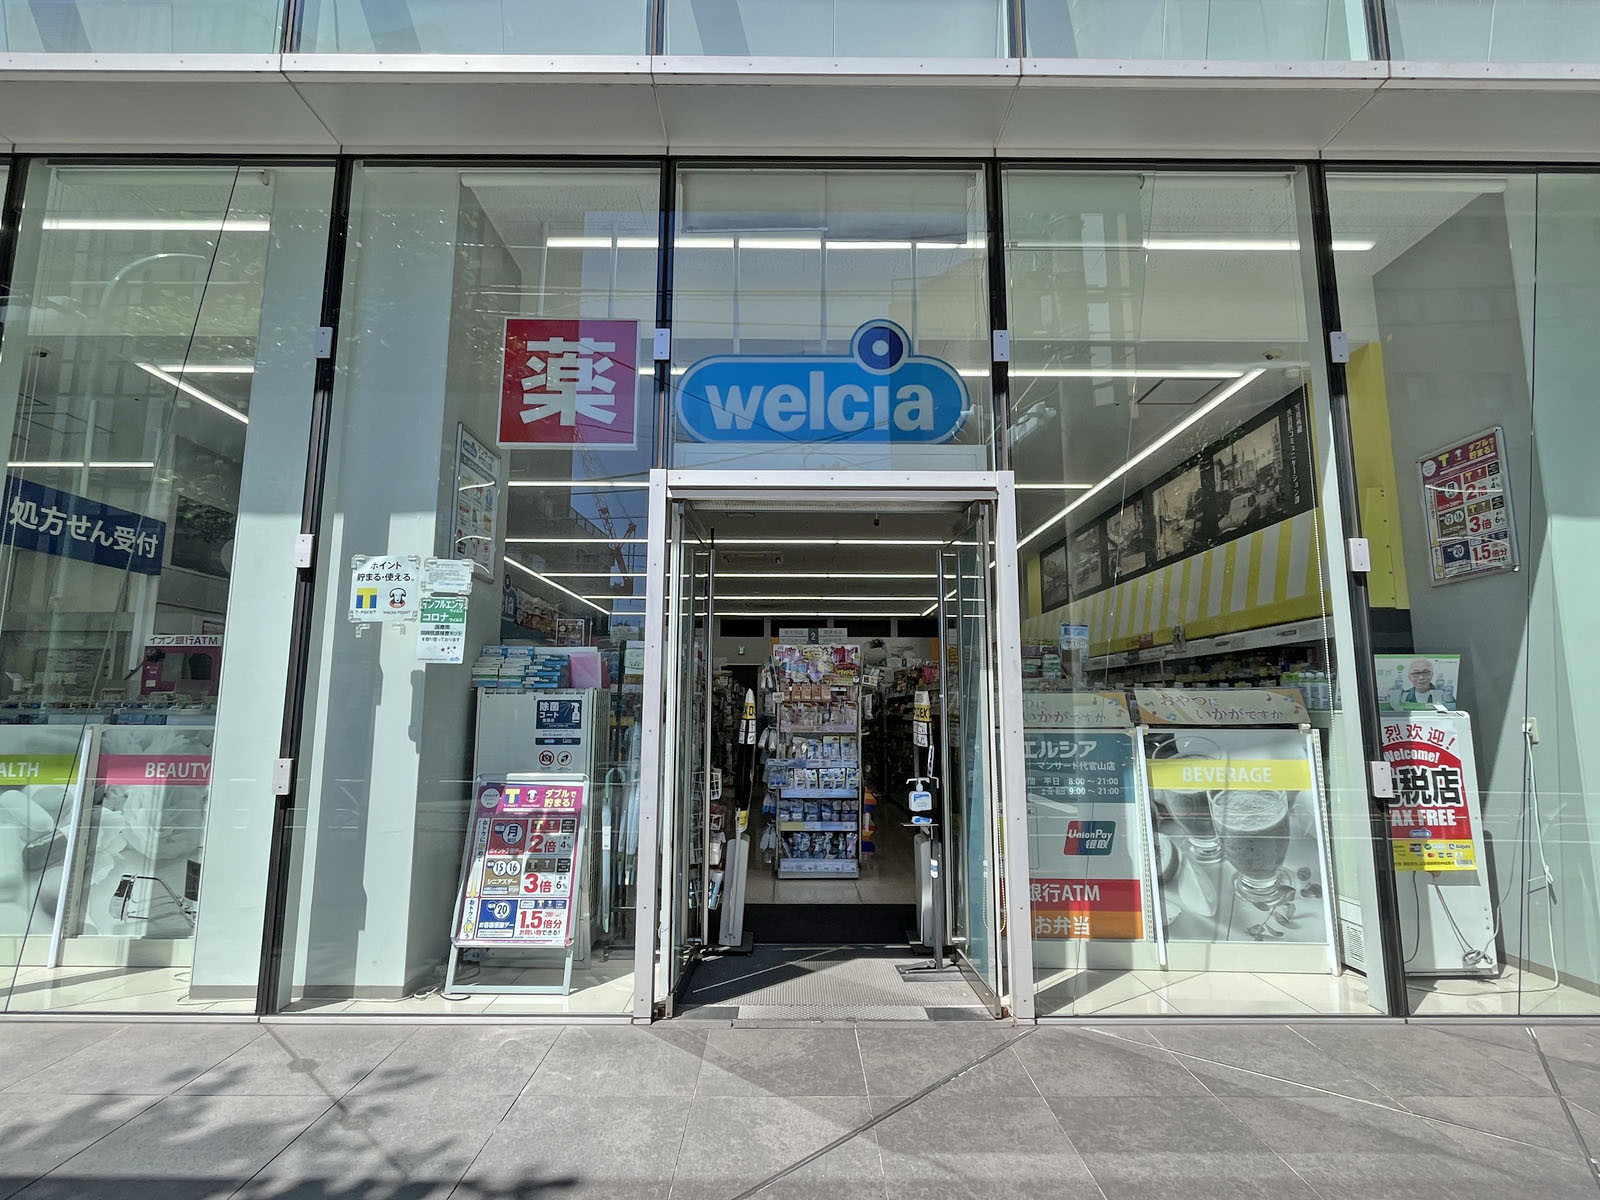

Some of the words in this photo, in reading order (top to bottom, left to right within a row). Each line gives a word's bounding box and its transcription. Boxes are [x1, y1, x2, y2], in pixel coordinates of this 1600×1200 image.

[519, 337, 617, 427] 薬
[704, 370, 936, 431] welcia
[9, 496, 159, 558] 処方せん受付
[370, 561, 402, 570] ポイント
[422, 613, 449, 622] コロナ
[150, 636, 218, 645] イオン銀行ATM
[810, 632, 816, 641] 2
[1160, 694, 1219, 708] おやつに
[1195, 708, 1284, 721] いかがですか
[1383, 748, 1440, 764] Welcome!
[145, 762, 211, 778] BEAUTY
[1037, 761, 1116, 771] マンサード代官山店
[1181, 766, 1272, 783] BEVERAGE
[545, 788, 577, 798] ダブルで
[1068, 787, 1086, 795] 9:00
[1098, 787, 1120, 795] 21:00
[543, 798, 575, 808] 貯まる!
[1389, 809, 1415, 826] AX
[1417, 809, 1457, 826] FREE
[507, 825, 519, 837] 月
[1068, 829, 1113, 842] UnionPay
[528, 834, 557, 853] 2倍
[495, 862, 504, 872] 15
[509, 862, 518, 872] 16
[523, 873, 552, 893] 3倍
[497, 905, 508, 915] 20
[519, 910, 562, 929] 1.5倍分
[1035, 915, 1091, 935] お弁当
